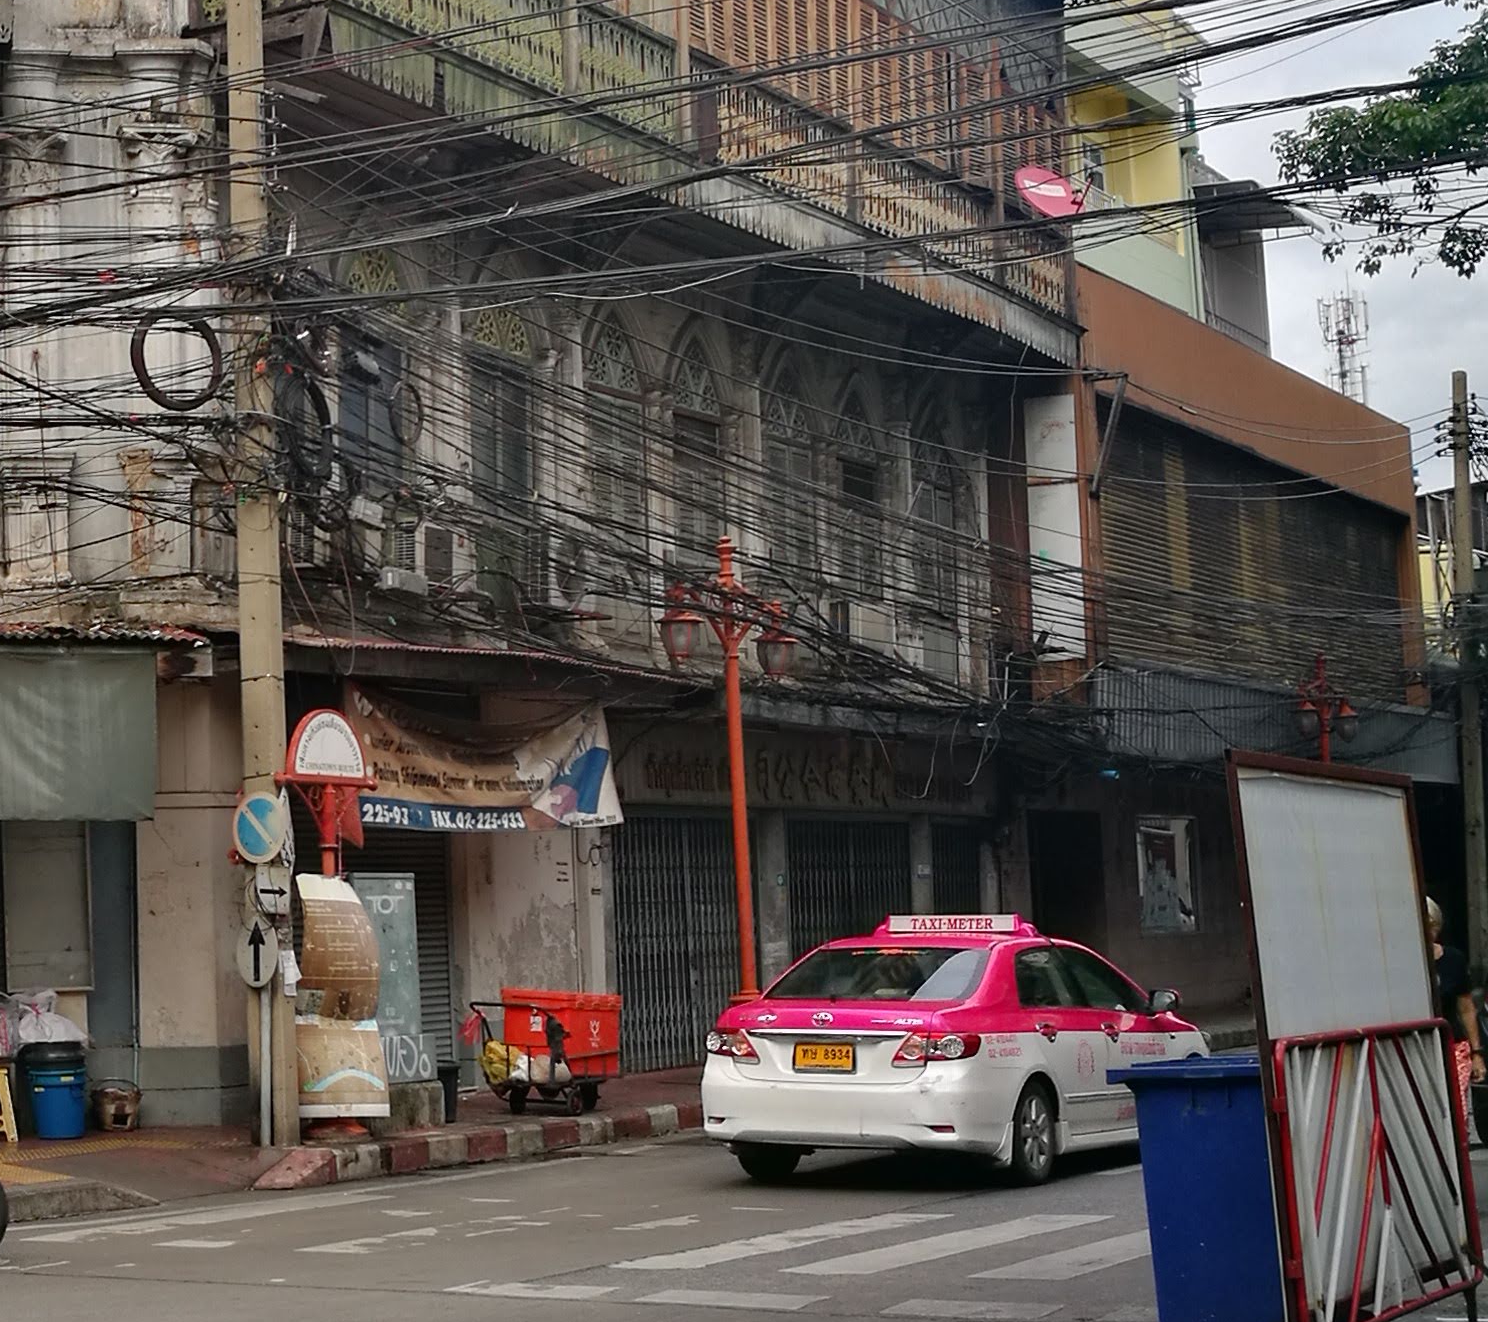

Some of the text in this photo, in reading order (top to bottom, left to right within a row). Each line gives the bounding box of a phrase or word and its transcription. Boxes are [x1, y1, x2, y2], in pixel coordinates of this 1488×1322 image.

[361, 802, 423, 826] 225-93
[365, 894, 405, 915] TOT
[910, 917, 994, 931] TAXI-METER
[823, 1047, 851, 1061] 8934
